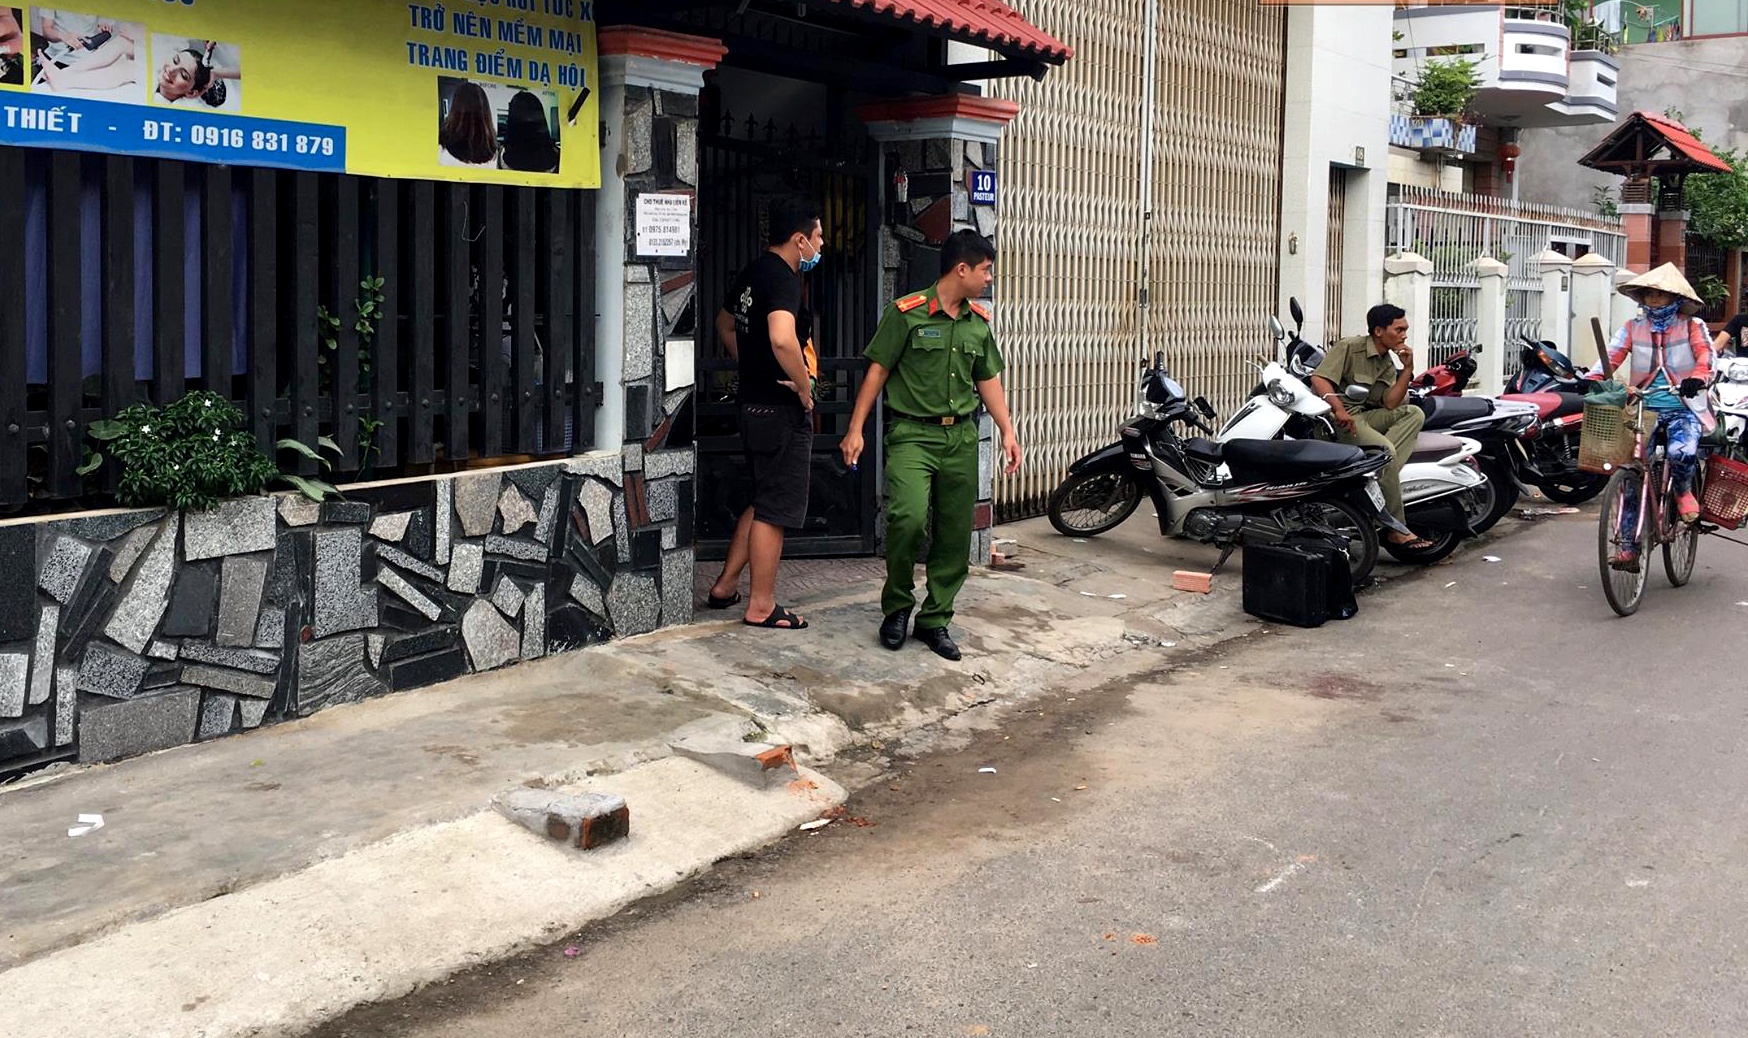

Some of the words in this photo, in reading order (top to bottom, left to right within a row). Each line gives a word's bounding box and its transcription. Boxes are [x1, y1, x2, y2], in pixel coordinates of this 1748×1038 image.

[408, 4, 445, 32] TRỞ
[452, 11, 491, 39] NÊN
[498, 17, 542, 47] MỀM
[549, 29, 582, 56] MẠI
[406, 42, 468, 72] TRANG
[475, 48, 522, 79] ĐIỂM
[529, 60, 550, 87] DẠ
[558, 63, 585, 91] HỘI
[4, 106, 82, 134] THIẾT
[143, 120, 182, 143] ĐT:
[190, 125, 243, 148] 0916
[252, 131, 288, 152] 831
[296, 135, 334, 156] 879
[973, 192, 995, 201] PASTEUR
[977, 174, 991, 191] 10
